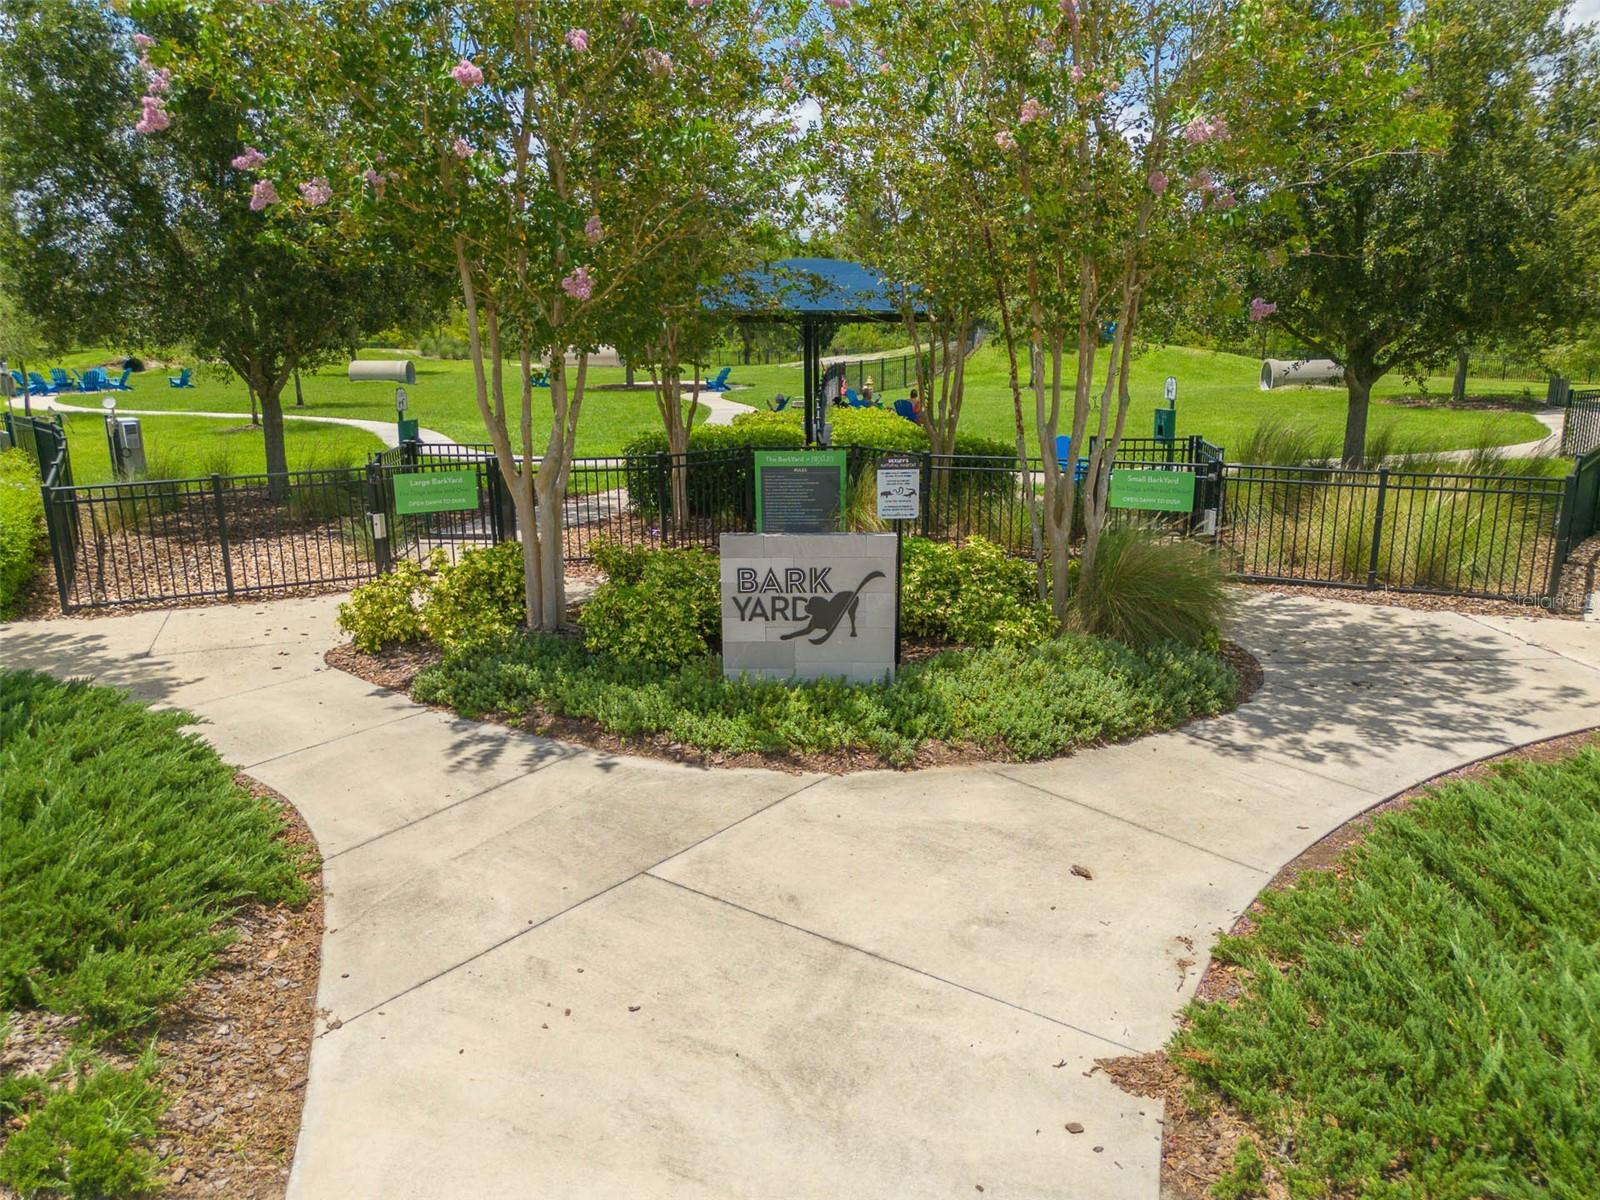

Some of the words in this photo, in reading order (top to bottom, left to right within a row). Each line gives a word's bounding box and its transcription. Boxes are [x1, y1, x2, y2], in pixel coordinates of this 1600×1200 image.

[432, 477, 464, 485] BarkYard
[1148, 476, 1180, 484] BarkYard
[737, 567, 833, 594] BARK
[731, 596, 811, 622] YARD
